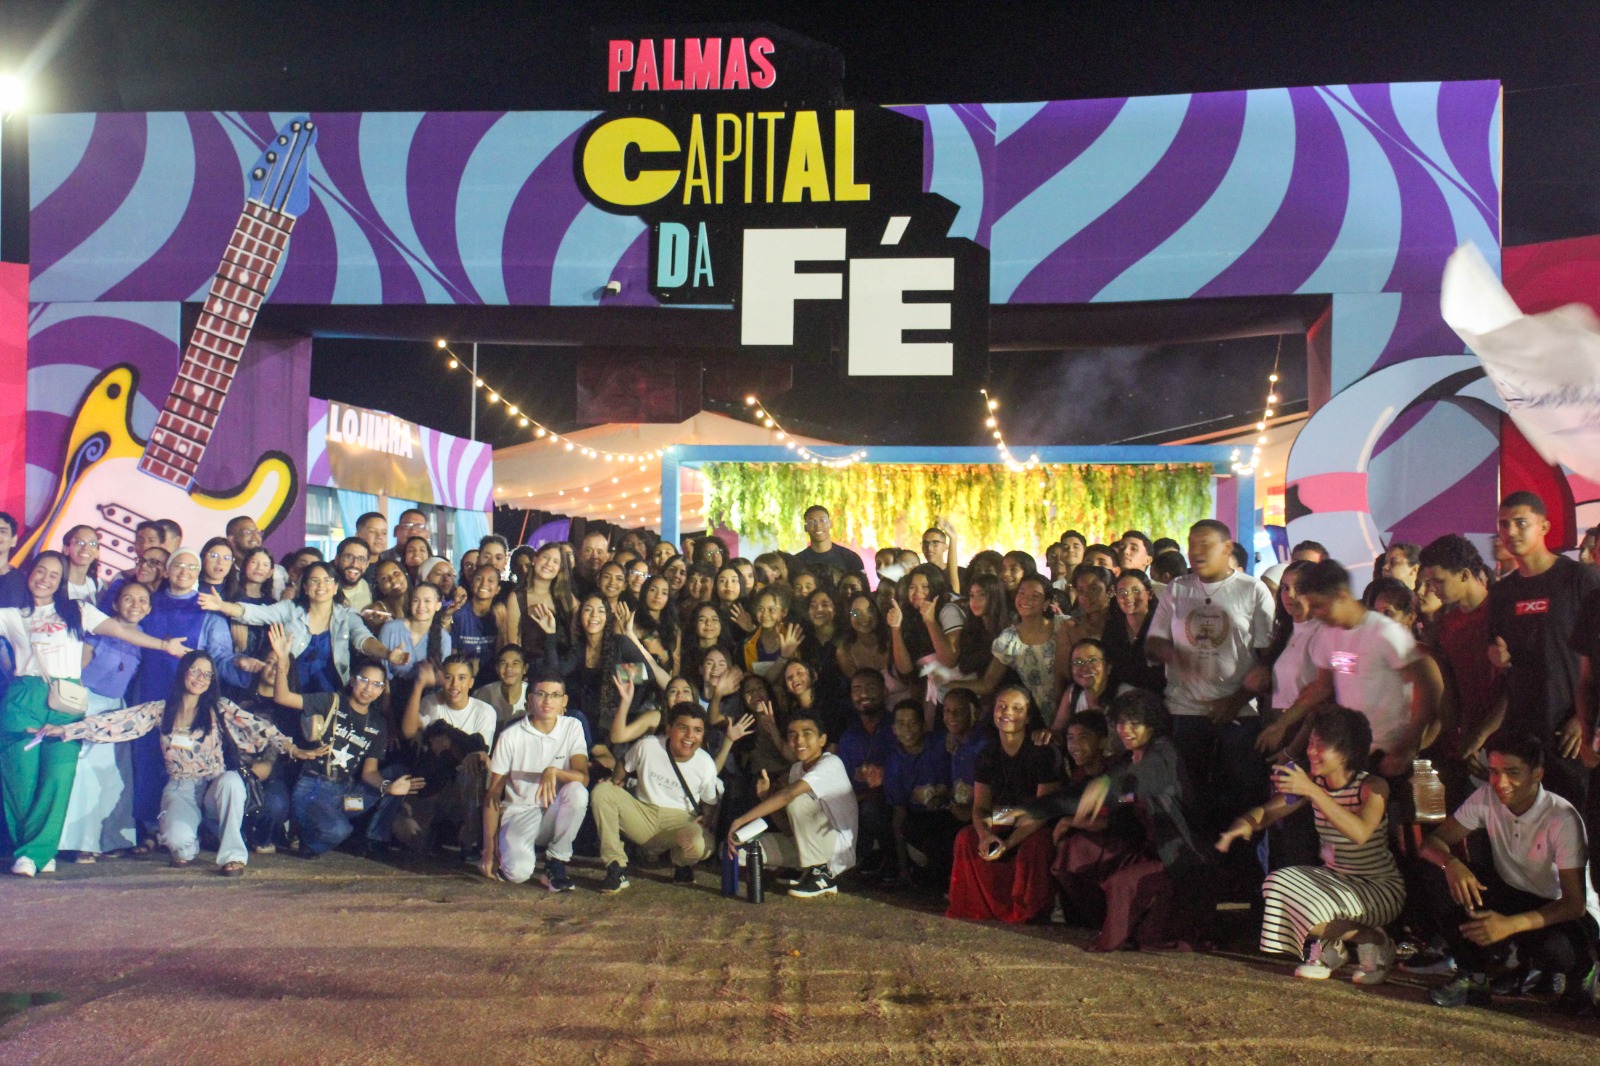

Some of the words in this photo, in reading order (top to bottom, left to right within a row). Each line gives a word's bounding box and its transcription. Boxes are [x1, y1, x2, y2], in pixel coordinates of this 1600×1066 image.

[607, 37, 777, 93] PALMAS
[582, 108, 871, 206] CAPITAL
[656, 221, 715, 289] DA
[740, 215, 955, 376] FÉ
[328, 403, 413, 459] LOJINHA
